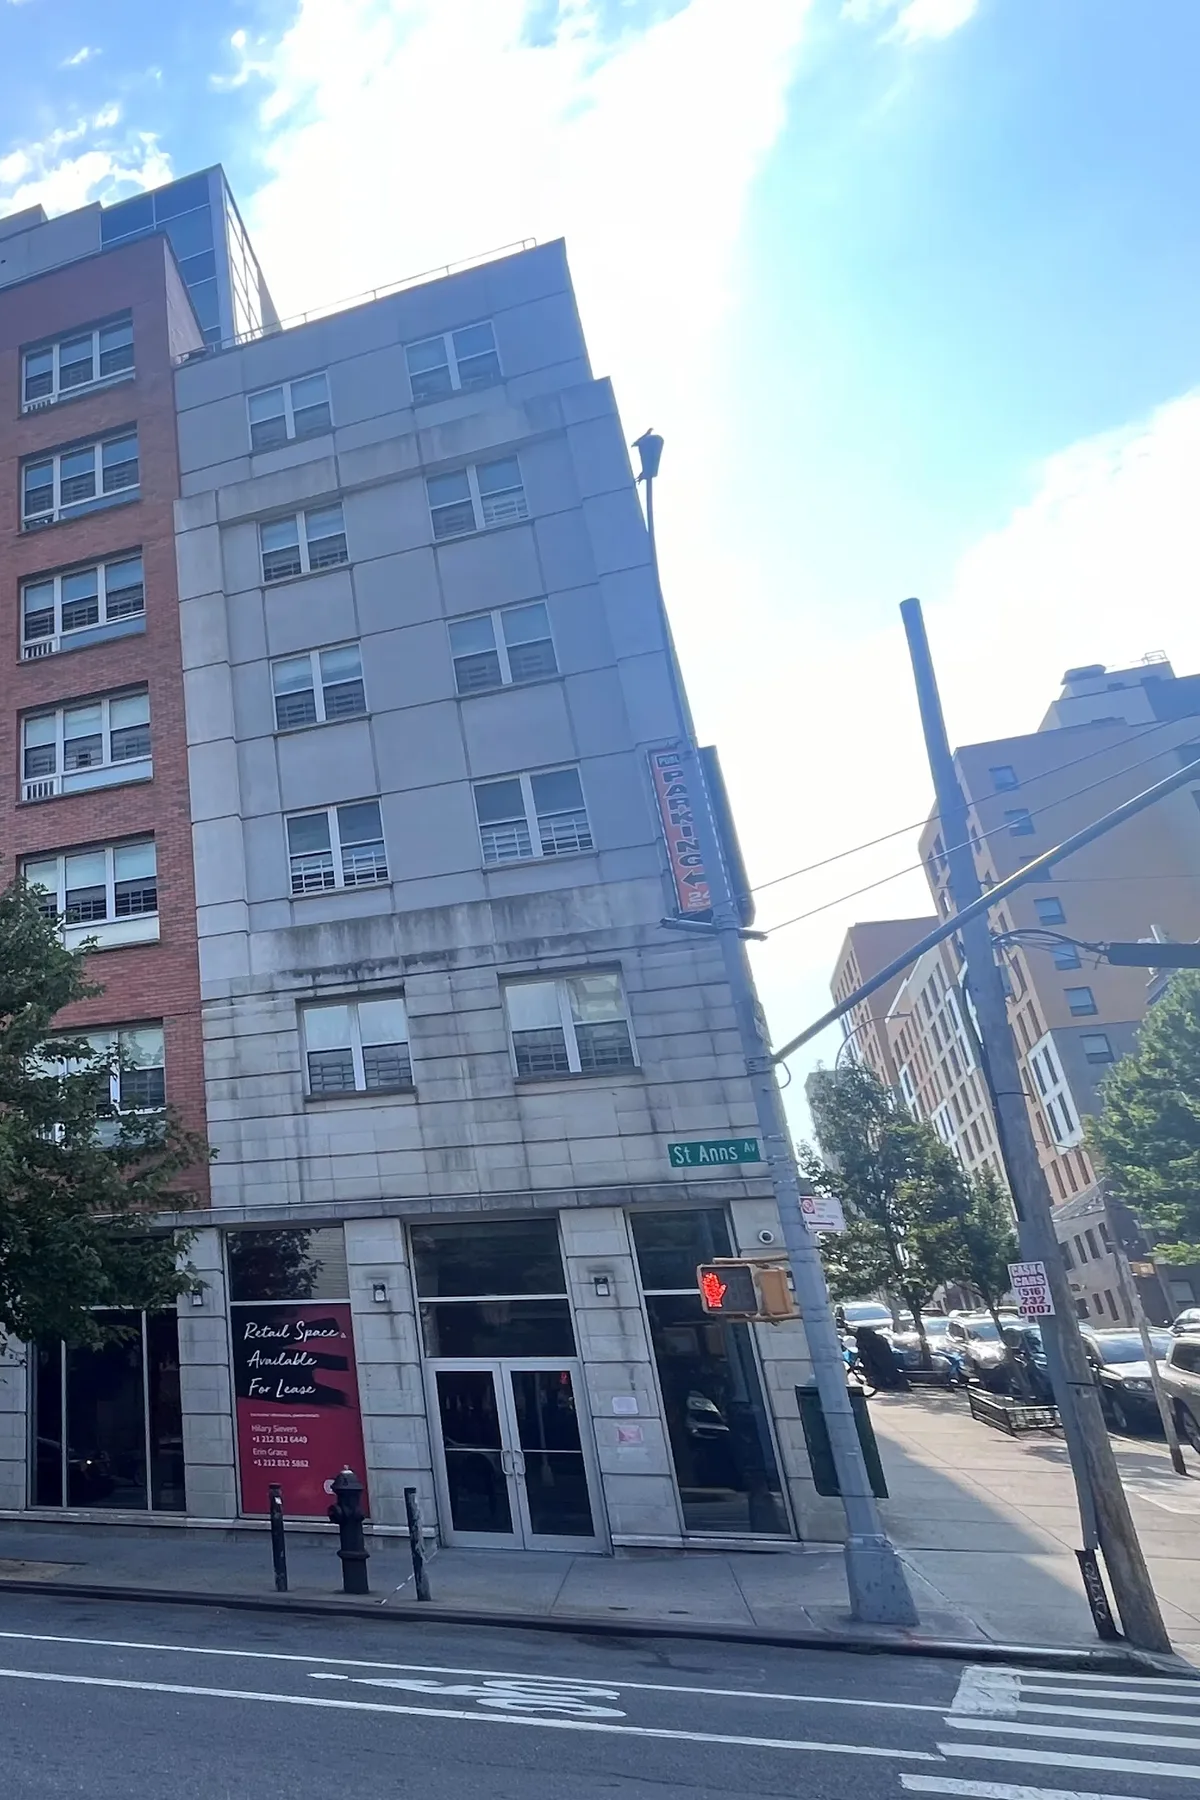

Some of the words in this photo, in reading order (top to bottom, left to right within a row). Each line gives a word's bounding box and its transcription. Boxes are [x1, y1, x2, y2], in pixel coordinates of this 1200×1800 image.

[673, 1145, 692, 1164] St
[699, 1144, 739, 1163] Anns
[743, 1141, 756, 1153] Av
[1011, 1264, 1037, 1277] CASH
[1013, 1274, 1046, 1287] CARS
[1017, 1286, 1046, 1297] (516)
[1020, 1296, 1046, 1306] 232
[1018, 1304, 1051, 1315] 0007
[243, 1321, 290, 1341] Retail
[294, 1320, 339, 1342] Space
[246, 1349, 318, 1369] Available
[248, 1377, 272, 1396] For
[275, 1378, 317, 1398] Lease
[261, 1435, 275, 1443] 212
[263, 1459, 276, 1467] 212
